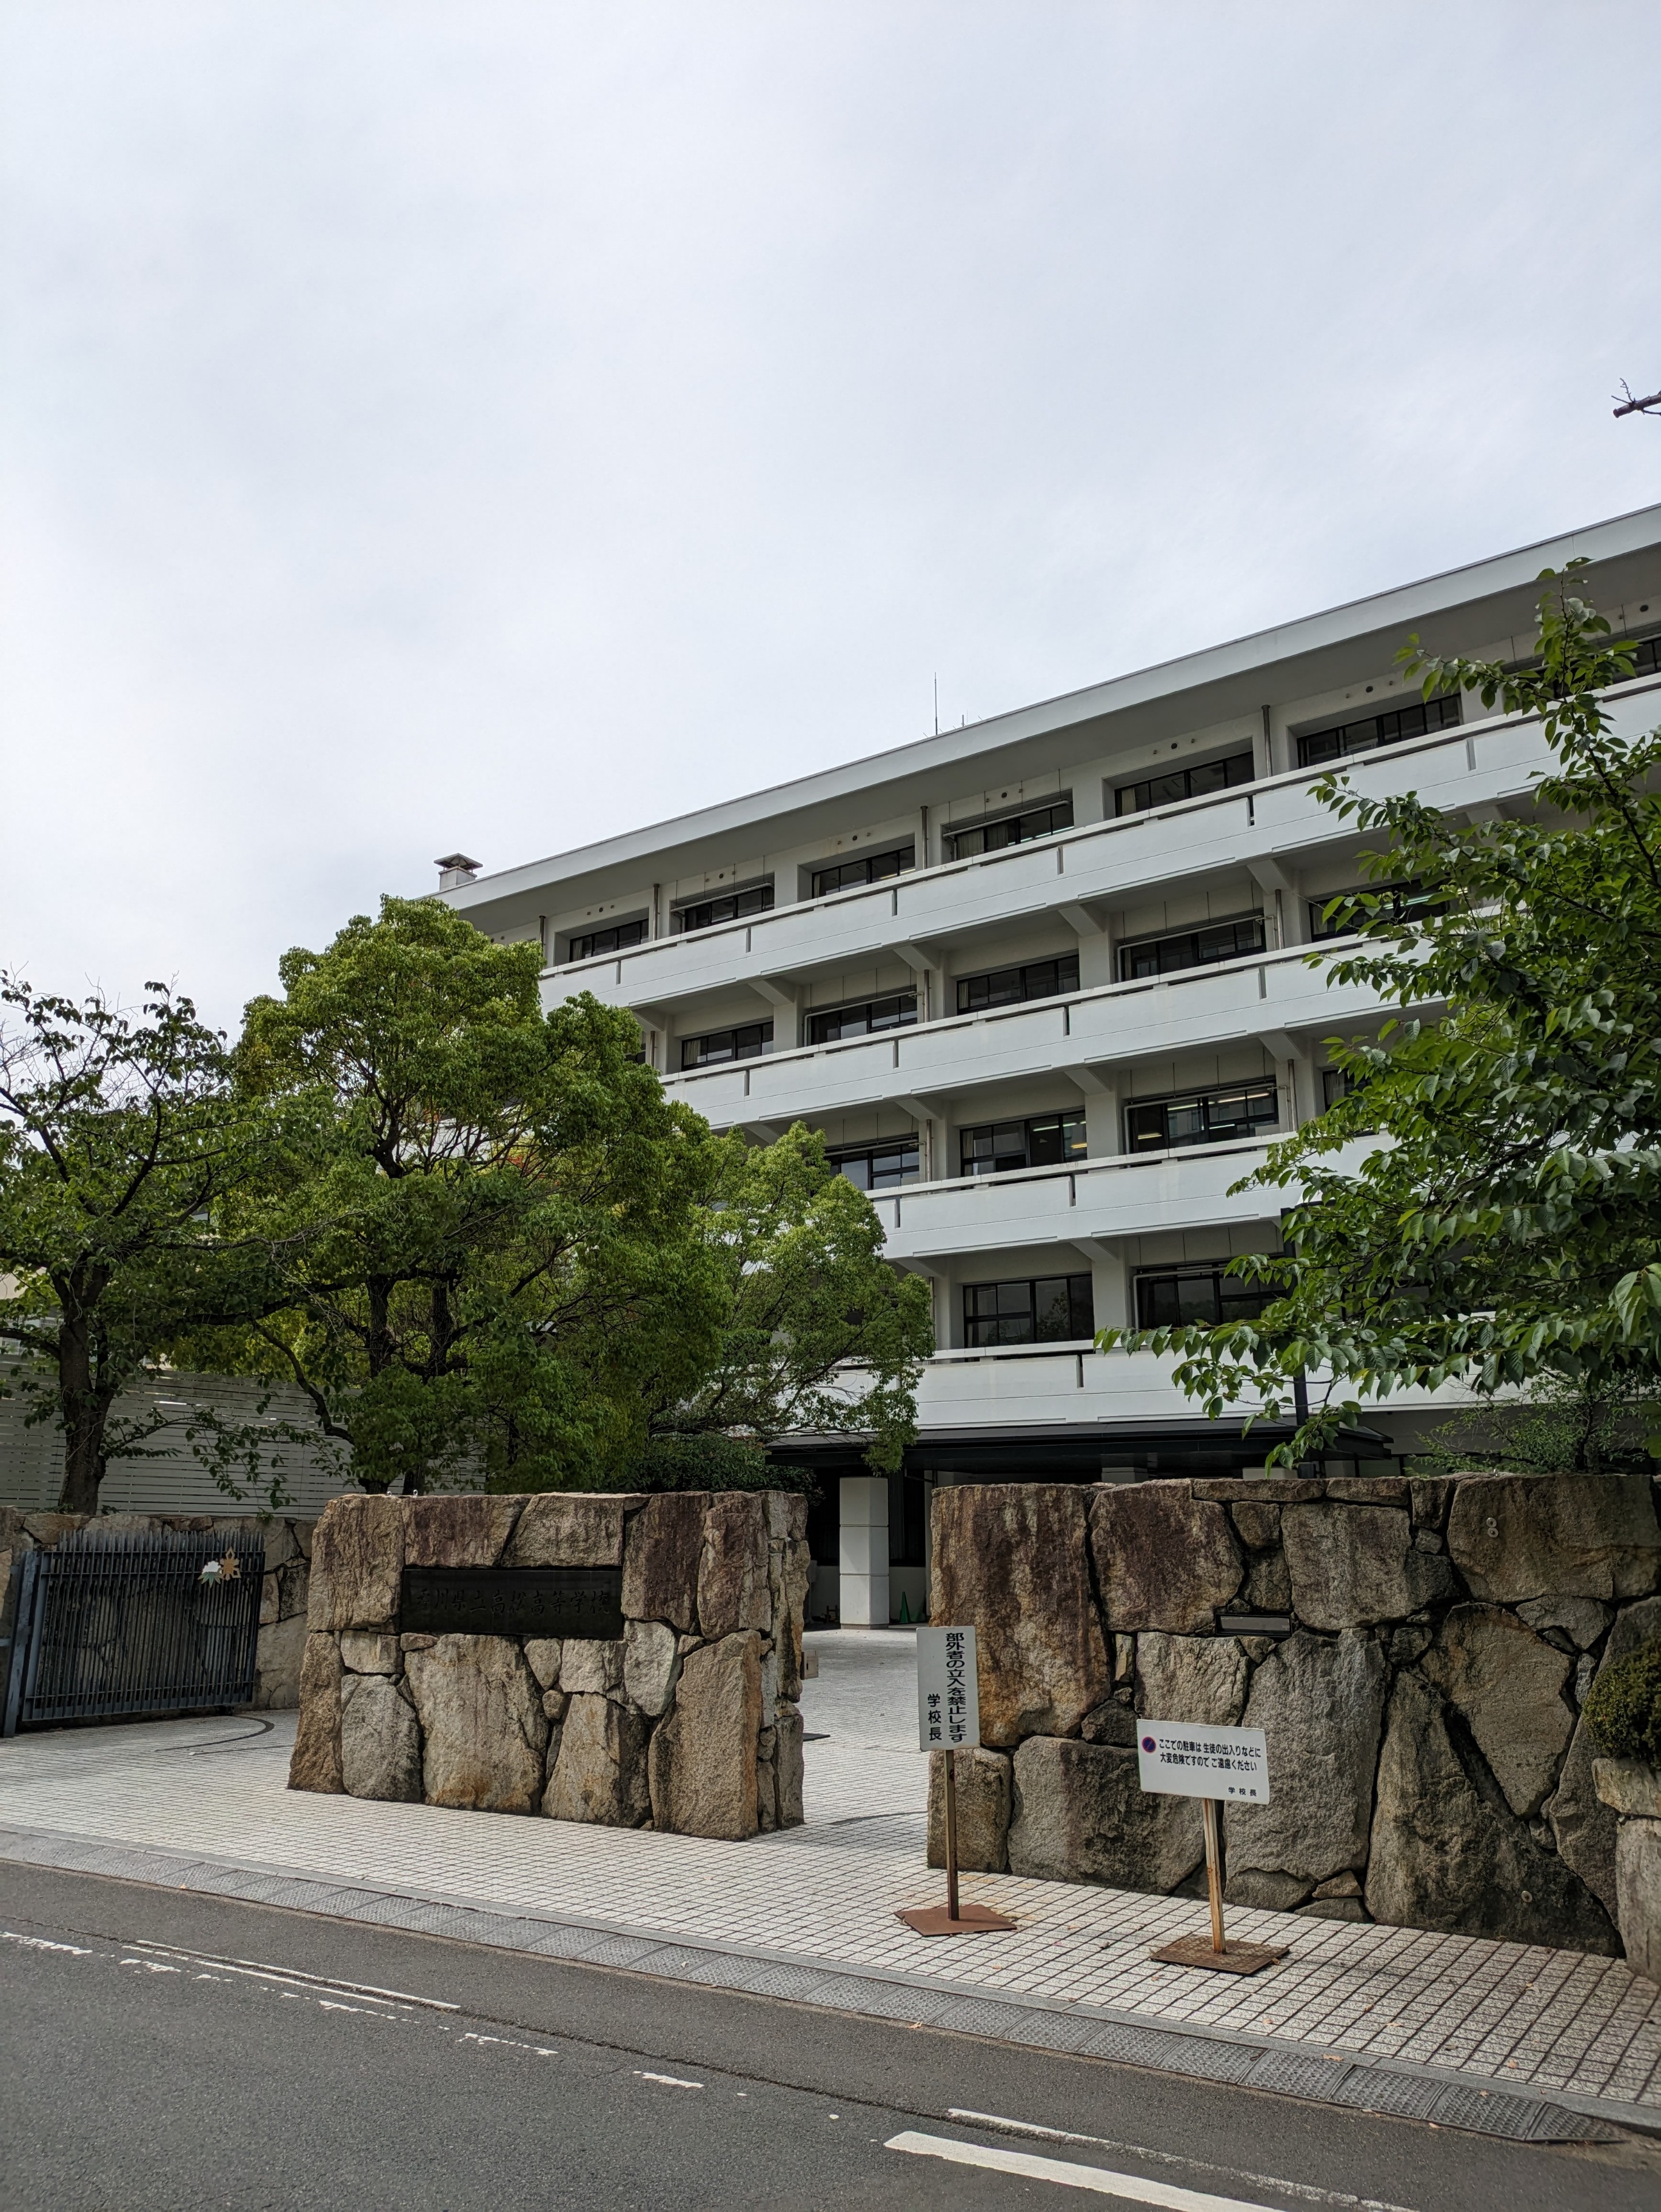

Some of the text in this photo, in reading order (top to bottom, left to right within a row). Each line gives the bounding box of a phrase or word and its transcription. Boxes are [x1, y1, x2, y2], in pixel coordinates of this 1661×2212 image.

[416, 1588, 611, 1615] 香川県立高松高等学校
[946, 1632, 967, 1742] 部外者の立入を禁止します
[927, 1693, 942, 1741] 学校長
[1228, 1786, 1257, 1797] 学校長
